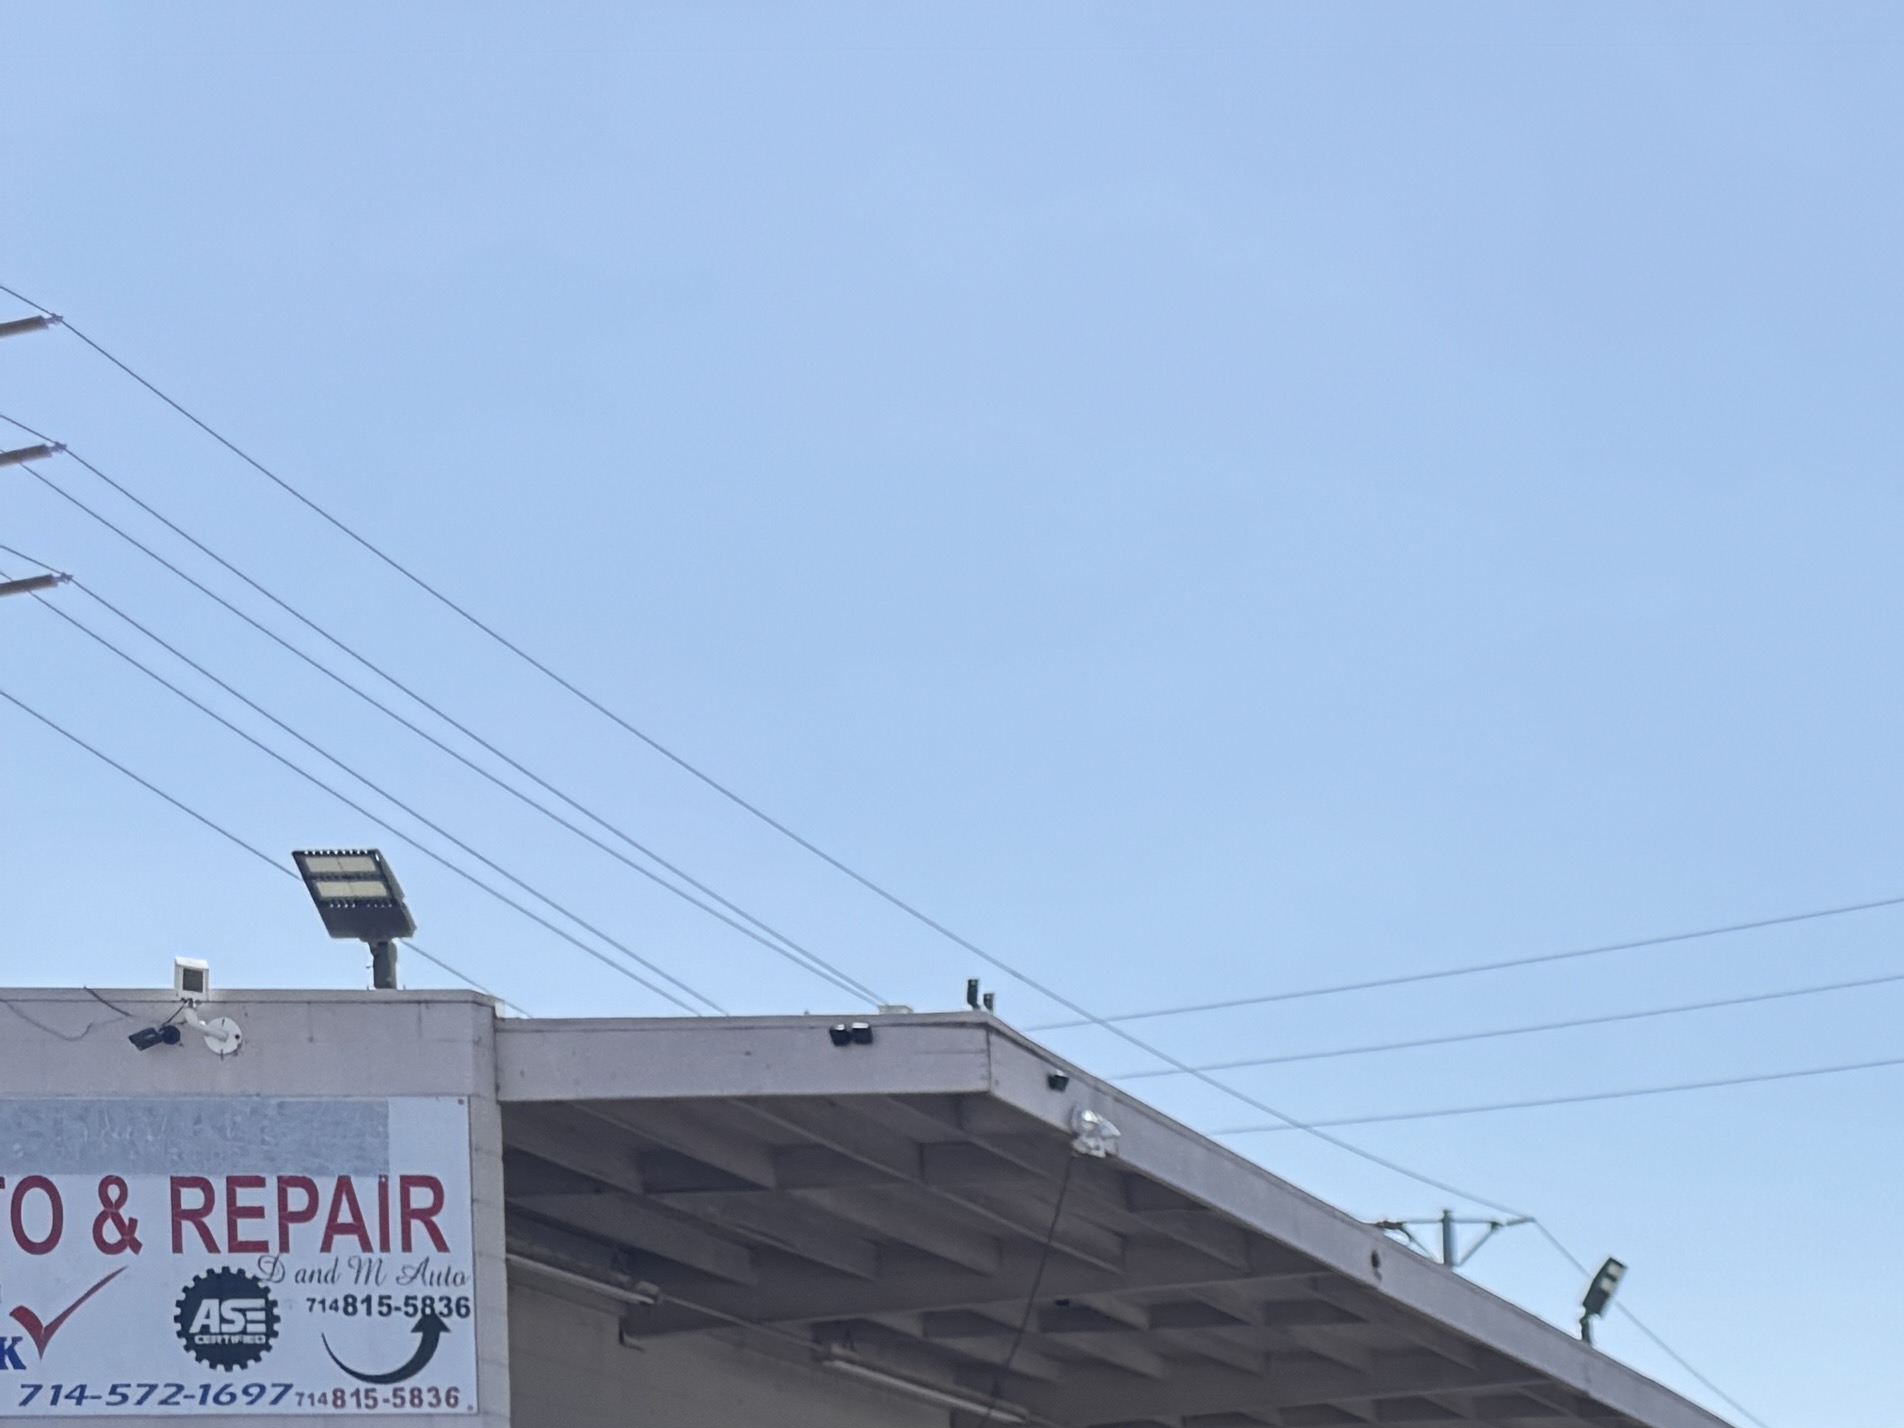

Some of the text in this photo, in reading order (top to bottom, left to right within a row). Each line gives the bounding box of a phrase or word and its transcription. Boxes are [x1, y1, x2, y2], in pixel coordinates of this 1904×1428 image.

[0, 1174, 450, 1256] O & REPAIR
[257, 1253, 469, 1288] D and M Auto
[189, 1298, 267, 1334] ASE
[194, 1334, 267, 1345] CERTIFIED
[18, 1382, 295, 1408] 714-572-1697
